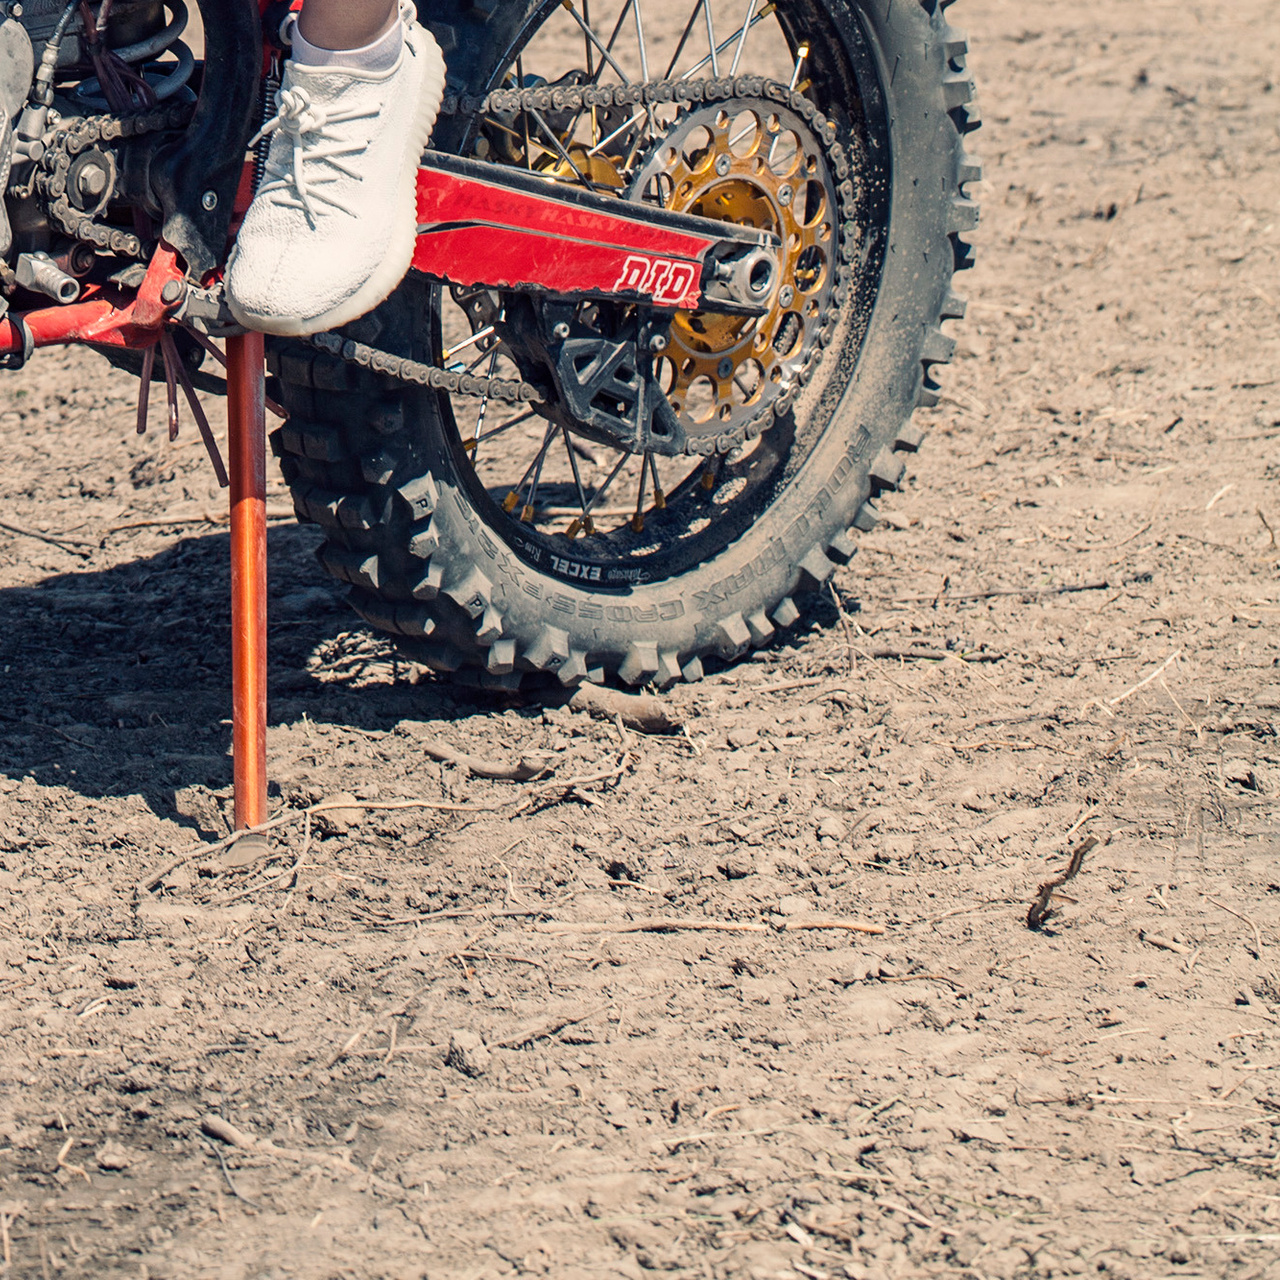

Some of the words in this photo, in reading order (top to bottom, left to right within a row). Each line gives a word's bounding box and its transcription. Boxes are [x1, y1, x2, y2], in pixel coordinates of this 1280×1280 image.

[614, 255, 695, 304] DID
[550, 554, 602, 581] EXCEL
[552, 591, 686, 623] CROSS
